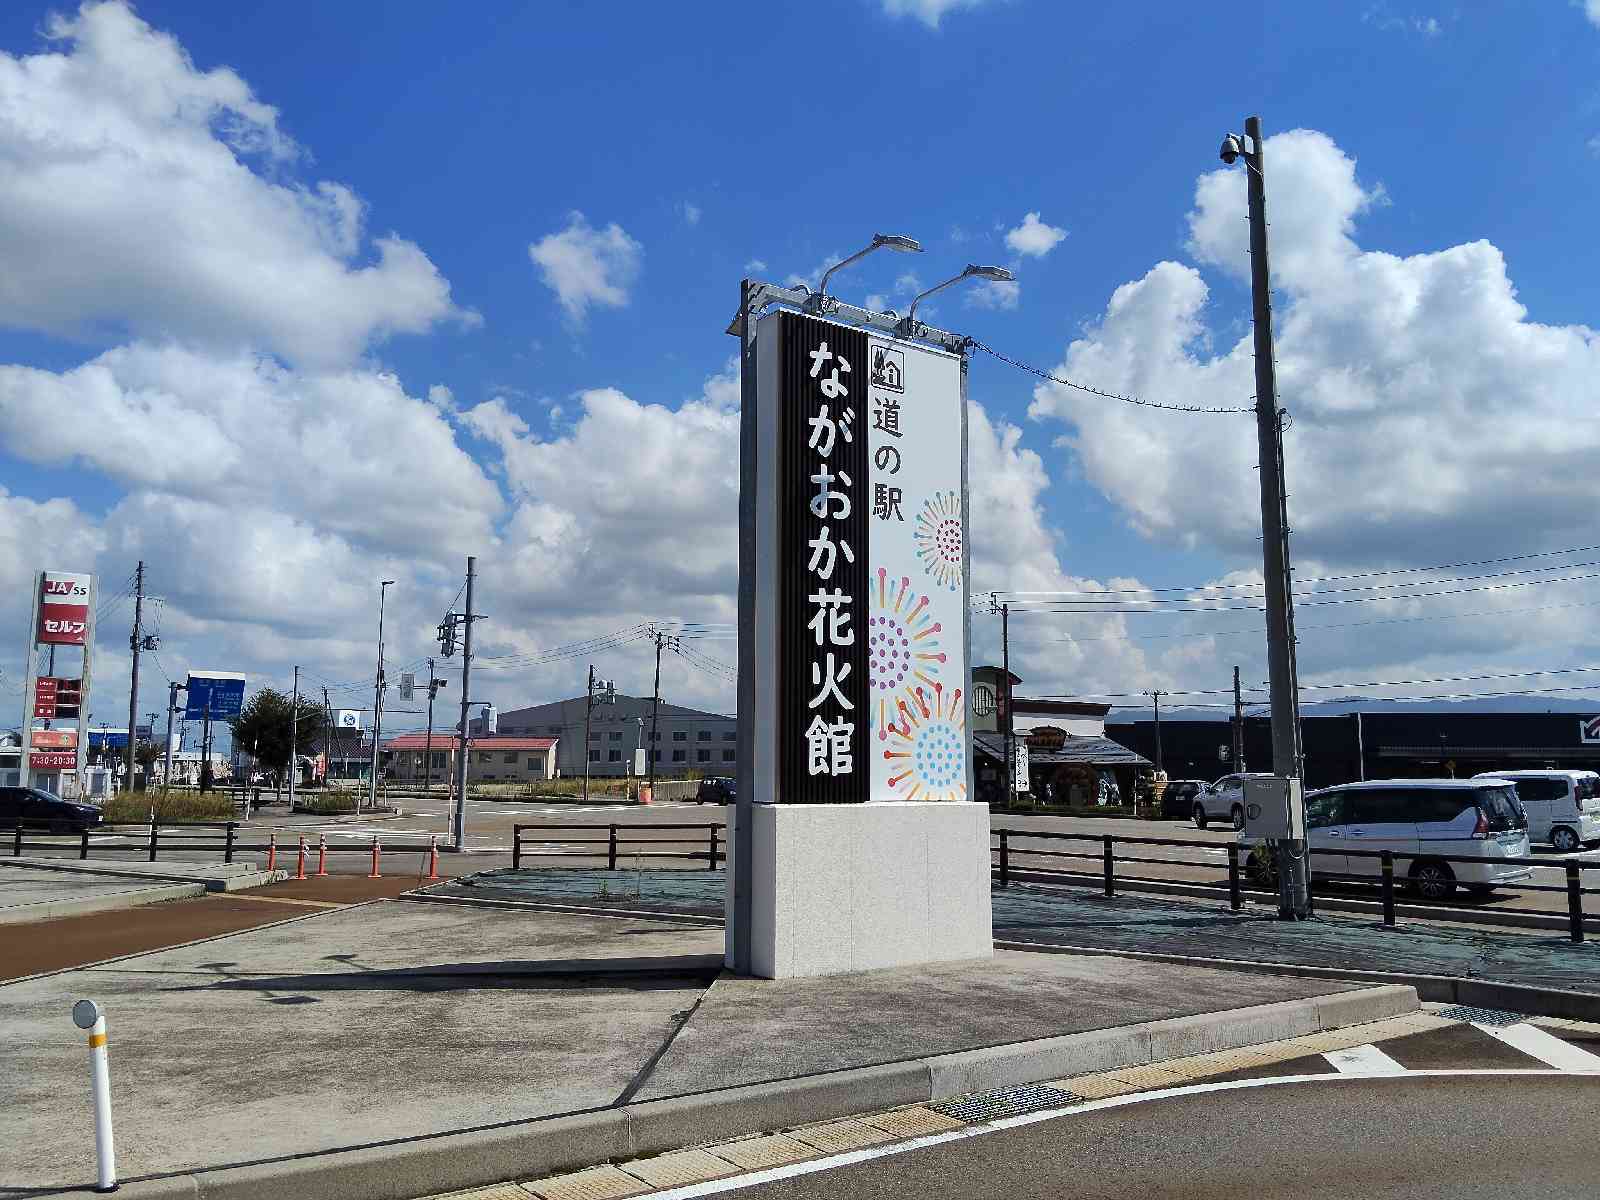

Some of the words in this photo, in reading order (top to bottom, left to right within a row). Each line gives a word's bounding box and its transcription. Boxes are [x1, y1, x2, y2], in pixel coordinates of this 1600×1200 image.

[872, 397, 905, 522] 道の駅
[805, 341, 856, 777] ながおか花火館
[44, 620, 85, 633] セルフ
